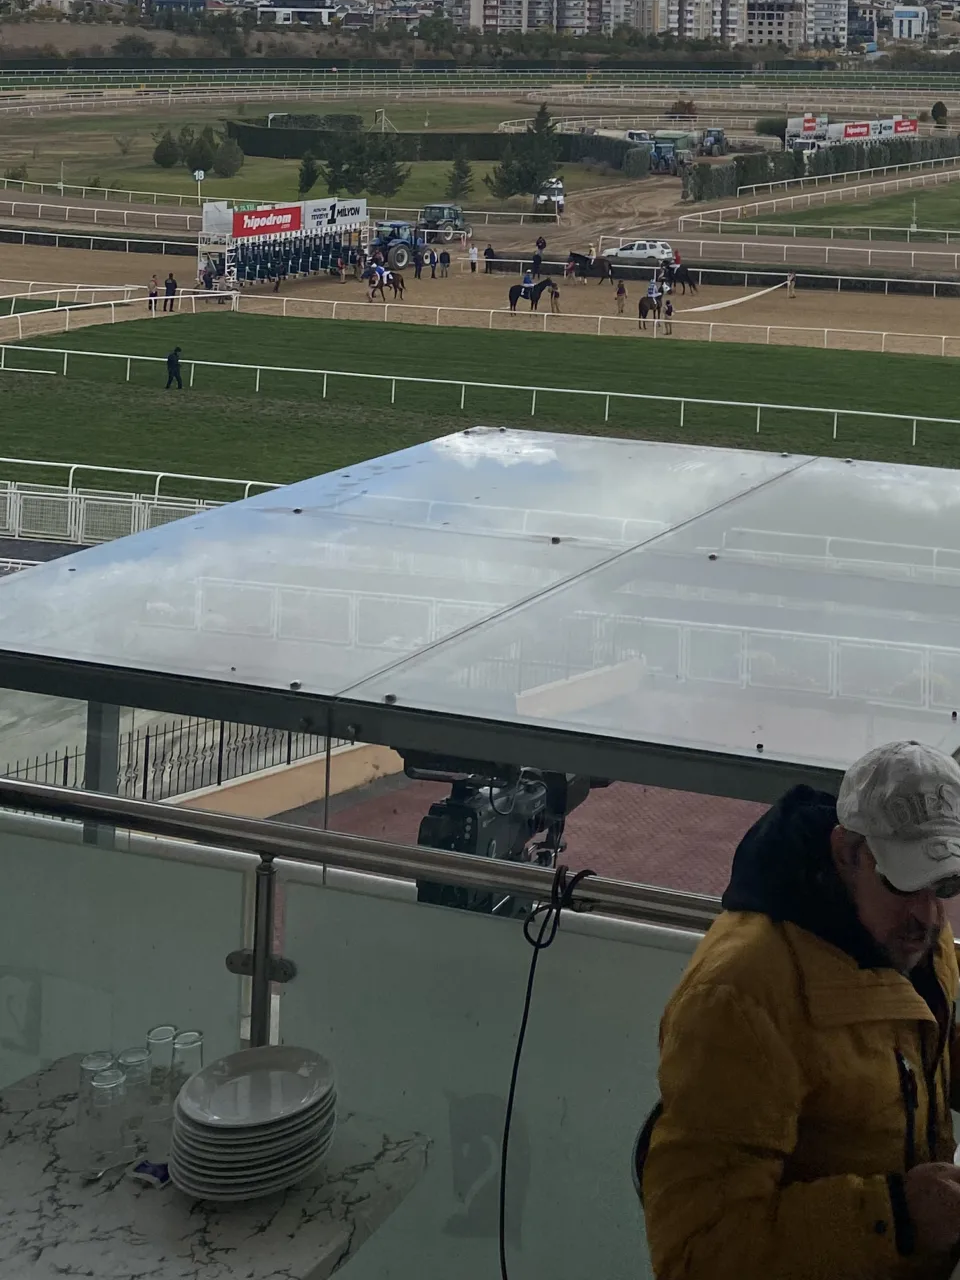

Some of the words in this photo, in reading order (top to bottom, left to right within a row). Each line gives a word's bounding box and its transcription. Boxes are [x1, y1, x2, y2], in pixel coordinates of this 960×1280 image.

[193, 170, 205, 181] 18
[243, 213, 292, 230] hipodrom
[327, 203, 337, 225] 1
[336, 206, 360, 218] MİLYON
